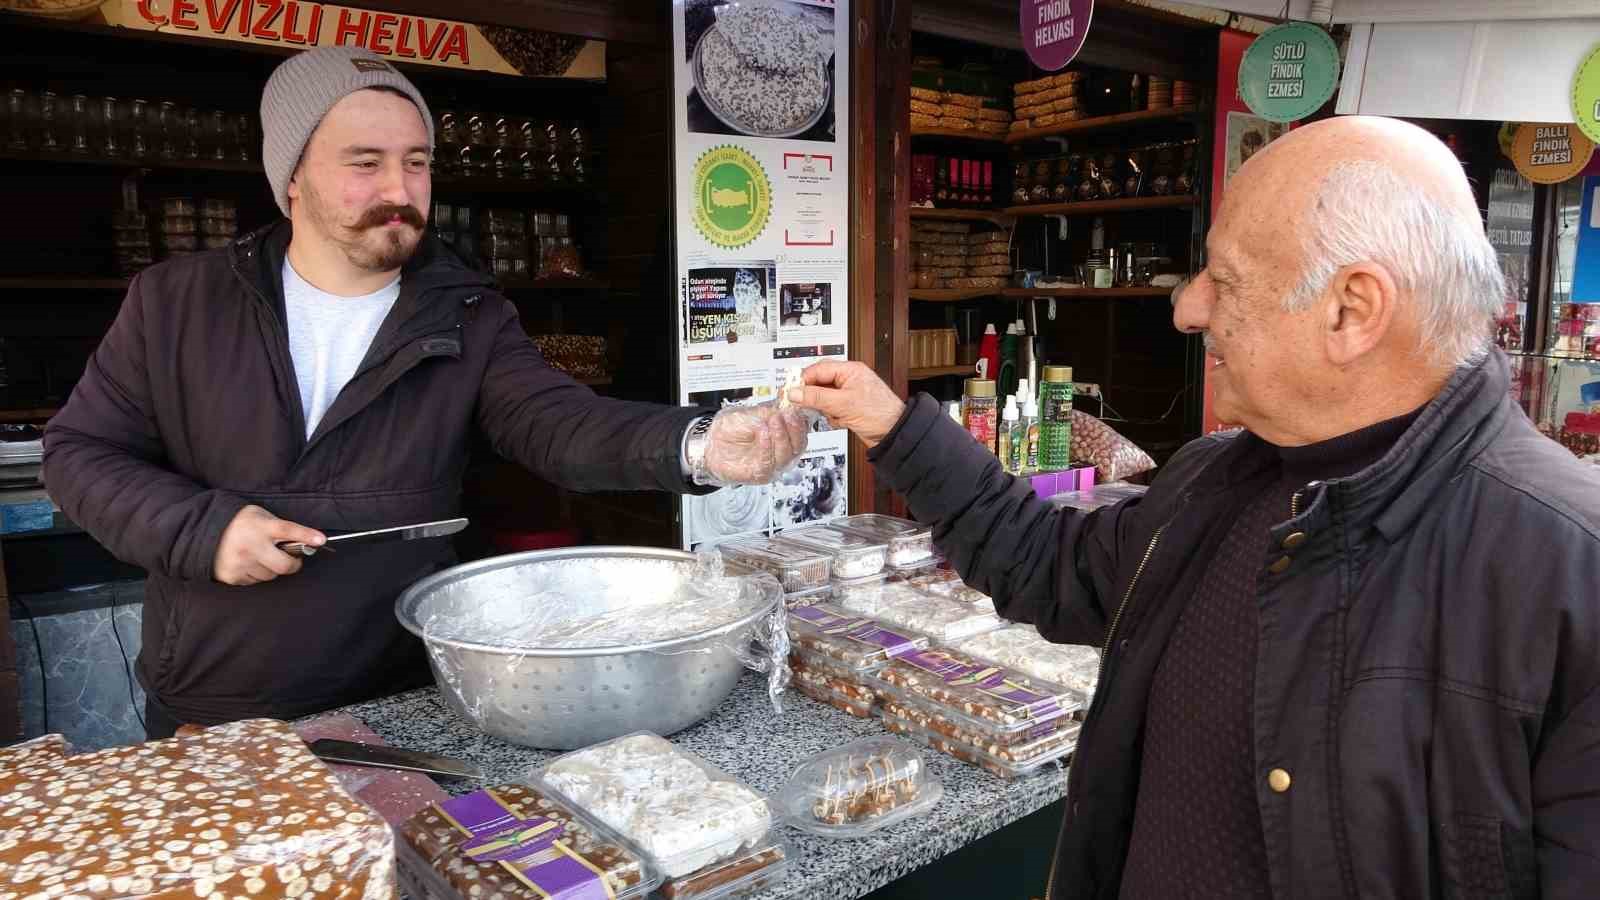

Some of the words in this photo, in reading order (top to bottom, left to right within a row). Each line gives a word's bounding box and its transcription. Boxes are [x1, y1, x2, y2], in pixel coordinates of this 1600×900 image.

[1038, 0, 1071, 24] FINDIK
[335, 8, 470, 64] HELVA
[1035, 18, 1074, 48] HELVASI
[1271, 64, 1304, 78] FINDIK
[1268, 80, 1303, 97] EZMESİ
[1536, 126, 1567, 138] BALLI
[1533, 139, 1569, 152] FINDIK
[1531, 150, 1570, 165] EZMESİ
